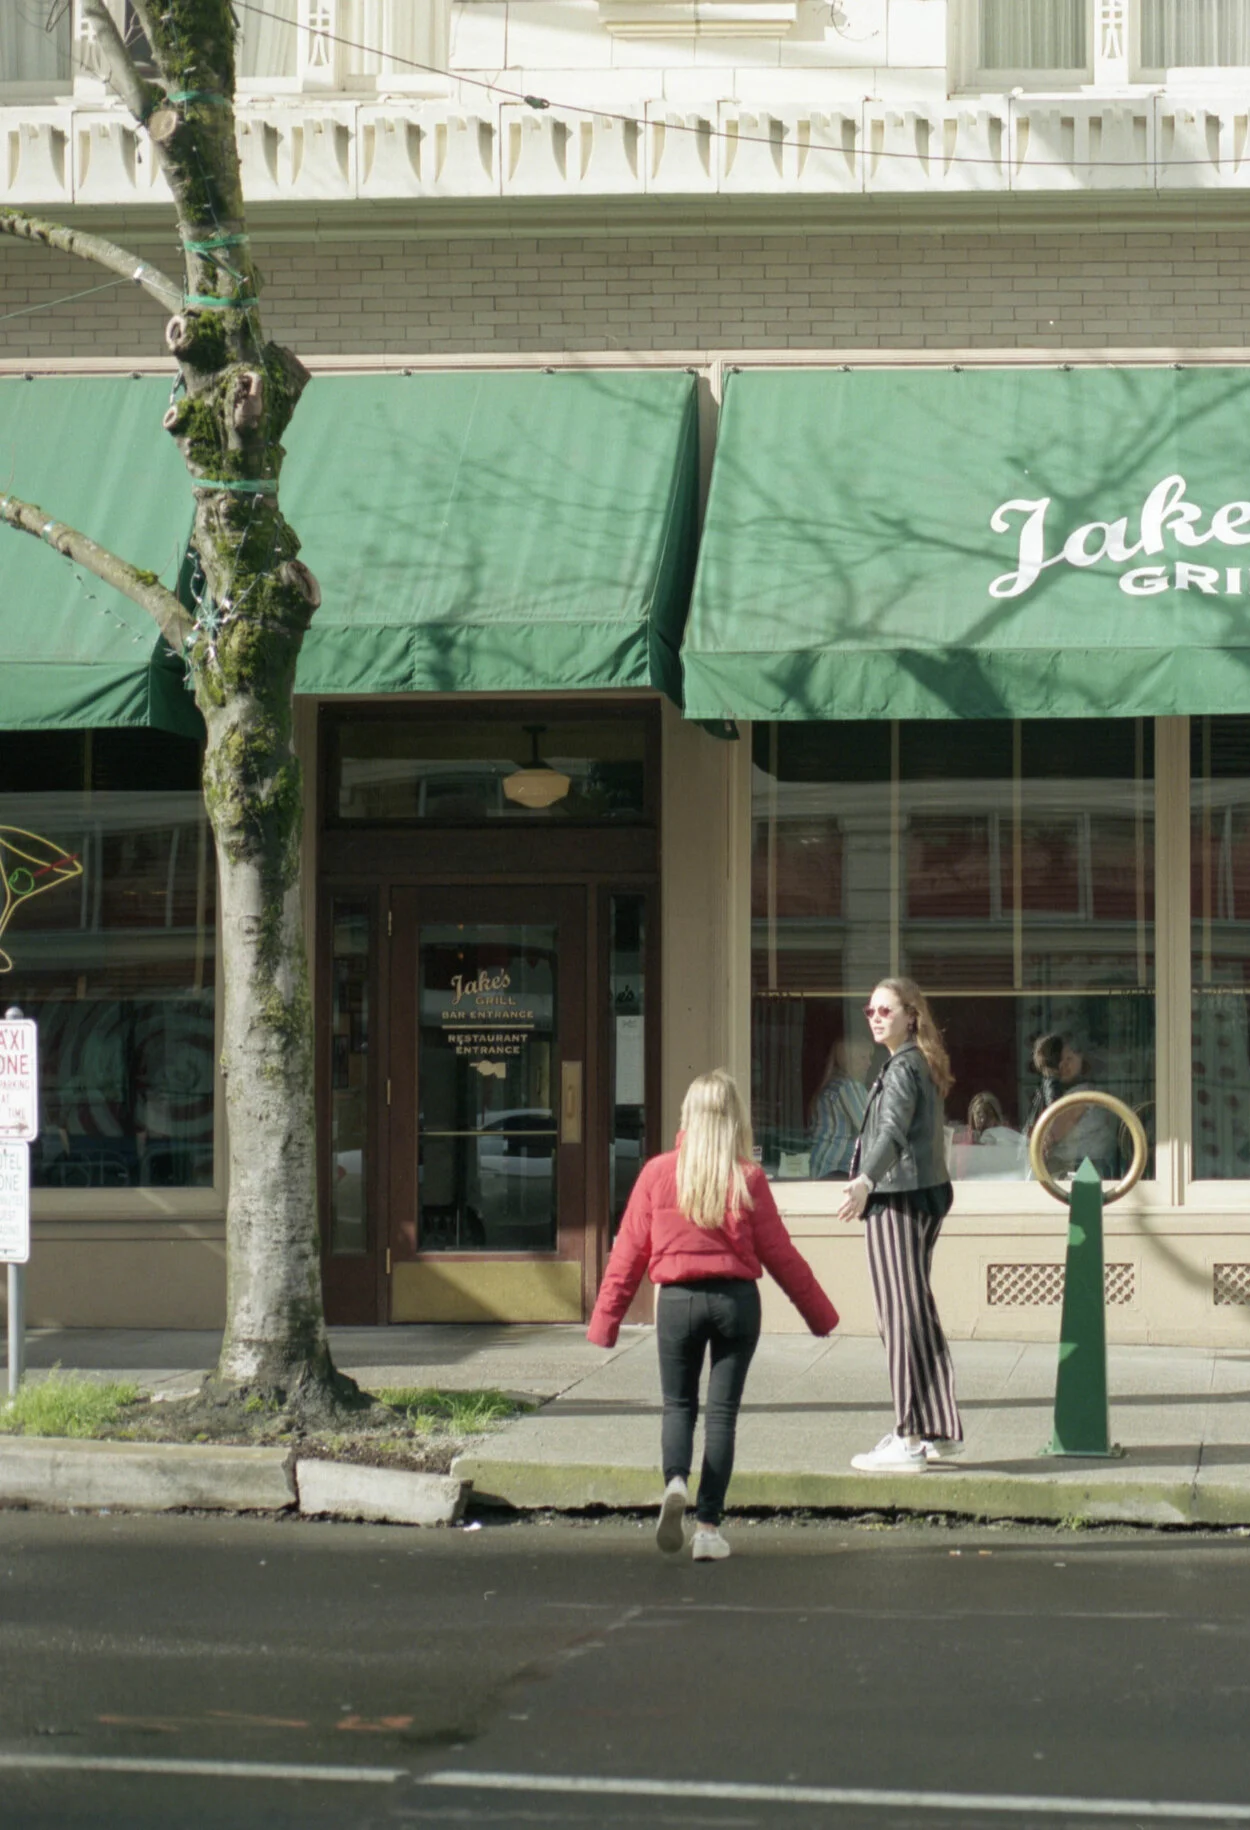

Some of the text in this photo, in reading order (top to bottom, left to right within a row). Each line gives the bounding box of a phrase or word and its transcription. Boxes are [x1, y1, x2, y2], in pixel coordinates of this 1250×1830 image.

[450, 967, 511, 1005] Jake's
[475, 996, 516, 1005] GRILL
[442, 1010, 534, 1019] BAR ENTRANCE
[0, 1029, 25, 1050] AXI
[448, 1033, 528, 1043] RESTAURANT
[456, 1045, 520, 1054] ENTRANCE
[0, 1055, 29, 1075] ONE
